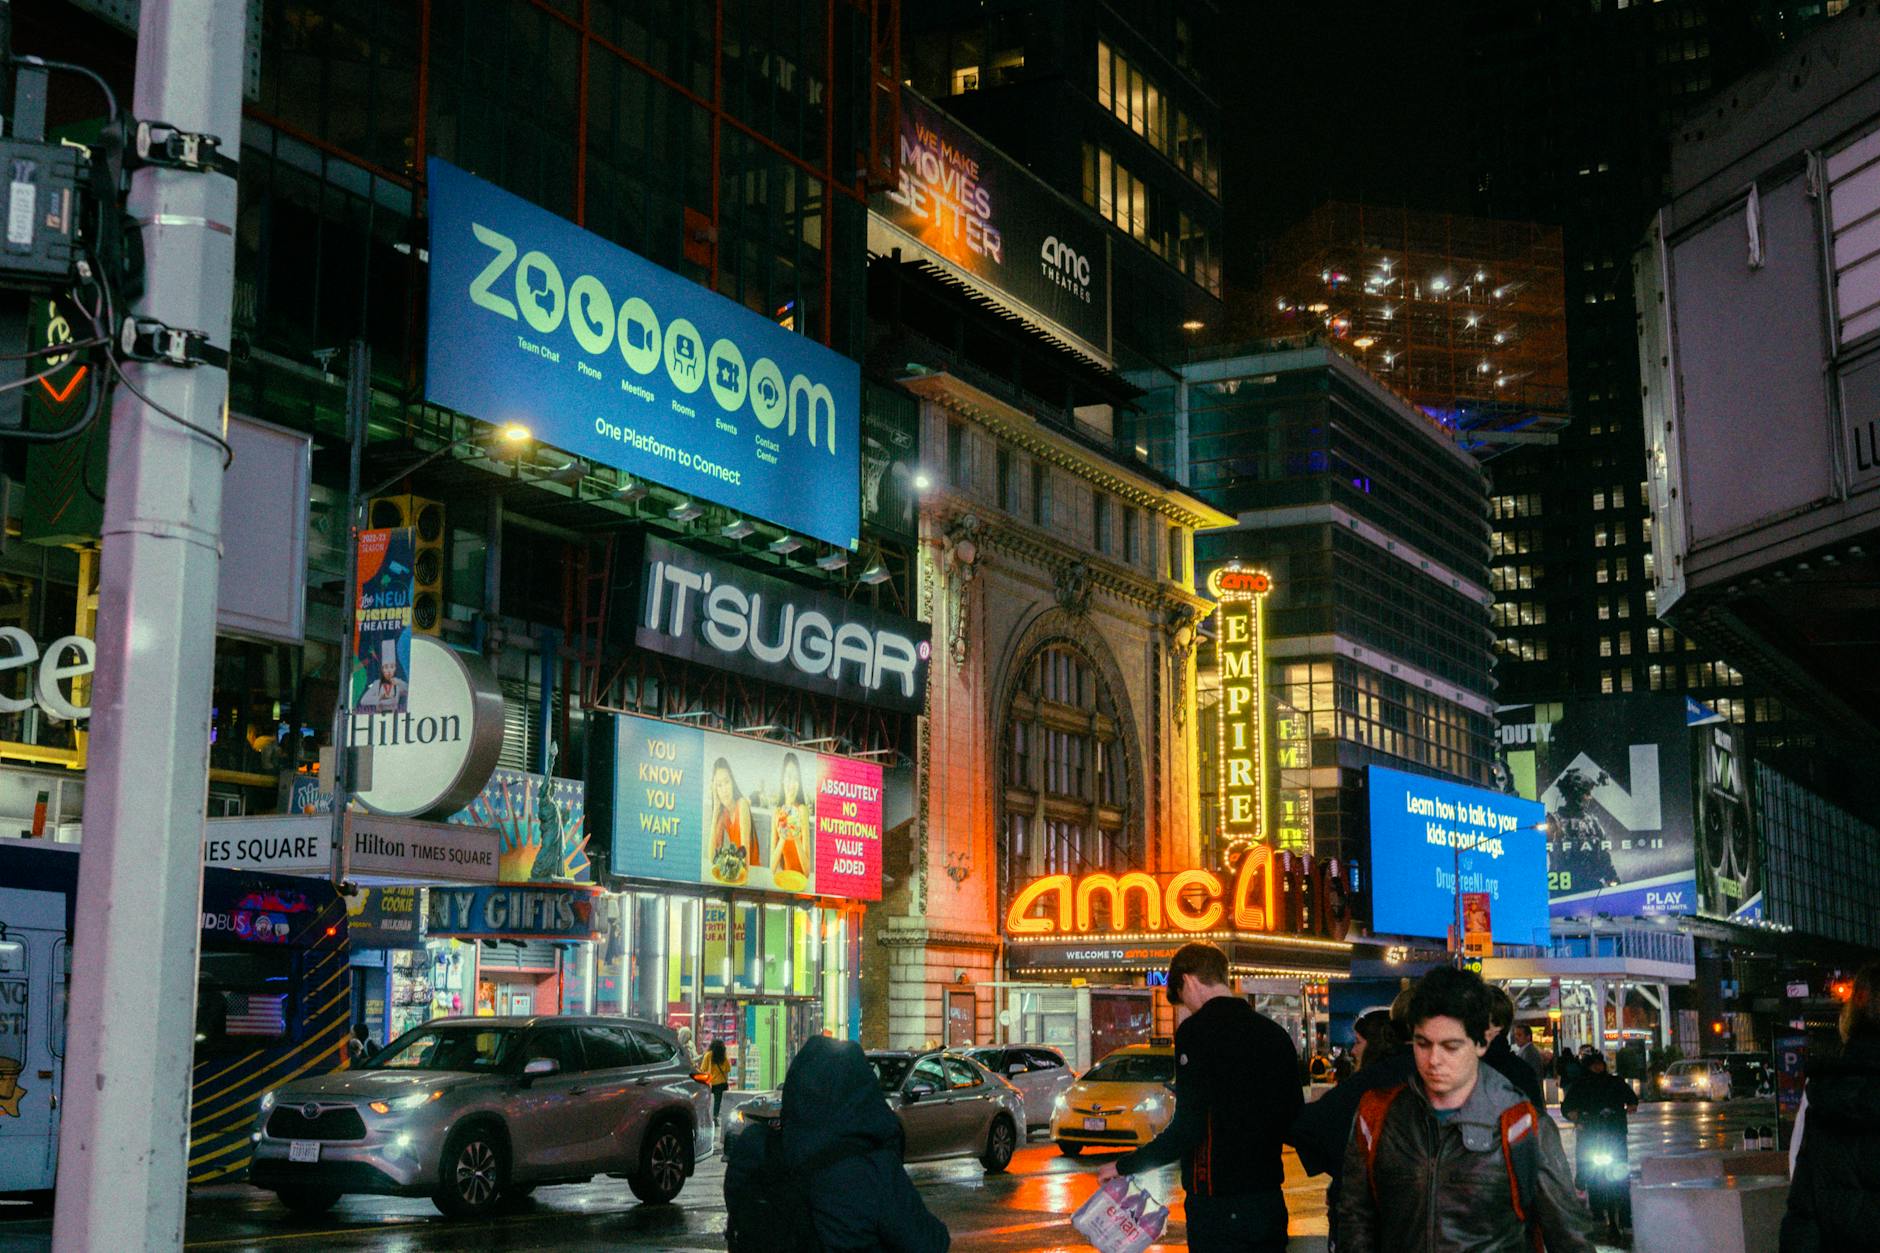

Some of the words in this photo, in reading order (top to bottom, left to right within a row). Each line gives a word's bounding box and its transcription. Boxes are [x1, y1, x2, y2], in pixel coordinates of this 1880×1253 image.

[915, 122, 937, 146] WE
[941, 139, 980, 179] MAKE
[901, 134, 991, 219] MOVIES
[1041, 235, 1090, 287] amc
[1041, 263, 1091, 304] THEATRES
[517, 336, 538, 355] Team
[539, 343, 560, 363] Chat
[577, 361, 602, 381] Phone
[621, 380, 655, 403] Meetings
[671, 400, 696, 418] Rooms
[715, 418, 738, 436] Events
[594, 417, 622, 443] One
[623, 425, 676, 462] Platform
[678, 445, 691, 468] to
[692, 453, 742, 486] Connect
[755, 434, 780, 452] Contact
[756, 449, 779, 465] Center
[362, 543, 385, 553] SEASON
[375, 590, 407, 607] NEW
[357, 620, 402, 632] THEATER
[645, 561, 917, 698] IT'SUGAR
[352, 710, 461, 747] Hilton
[1222, 615, 1253, 823] EMPIRE
[647, 738, 677, 761] YOU
[638, 762, 684, 786] KNOW
[646, 788, 676, 811] YOU
[820, 778, 880, 802] ABSOLUTELY
[842, 802, 858, 818] NO
[1406, 790, 1435, 815] Learn
[1435, 797, 1455, 820] how
[1457, 801, 1467, 824] to
[1468, 803, 1487, 825] talk
[1487, 807, 1498, 829] to
[1497, 812, 1519, 834] your
[639, 812, 681, 836] WANT
[820, 816, 879, 841] NUTRITIONAL
[236, 836, 320, 863] SQUARE
[354, 832, 406, 858] Hilton
[411, 843, 447, 862] TIMES
[448, 848, 493, 867] SQUARE
[652, 839, 666, 861] IT
[834, 839, 864, 858] VALUE
[1426, 822, 1447, 846] kids
[1477, 836, 1505, 860] drugs.
[832, 858, 866, 876] ADDED
[1547, 871, 1572, 891] 28
[381, 896, 415, 913] COOKIE
[484, 889, 576, 930] GIFTS
[1006, 869, 1224, 933] amc
[1646, 891, 1683, 905] PLAY
[380, 918, 413, 931] MILKMAN
[1066, 950, 1110, 961] WELCOME
[1111, 950, 1124, 960] TO
[1106, 1206, 1140, 1242] evian
